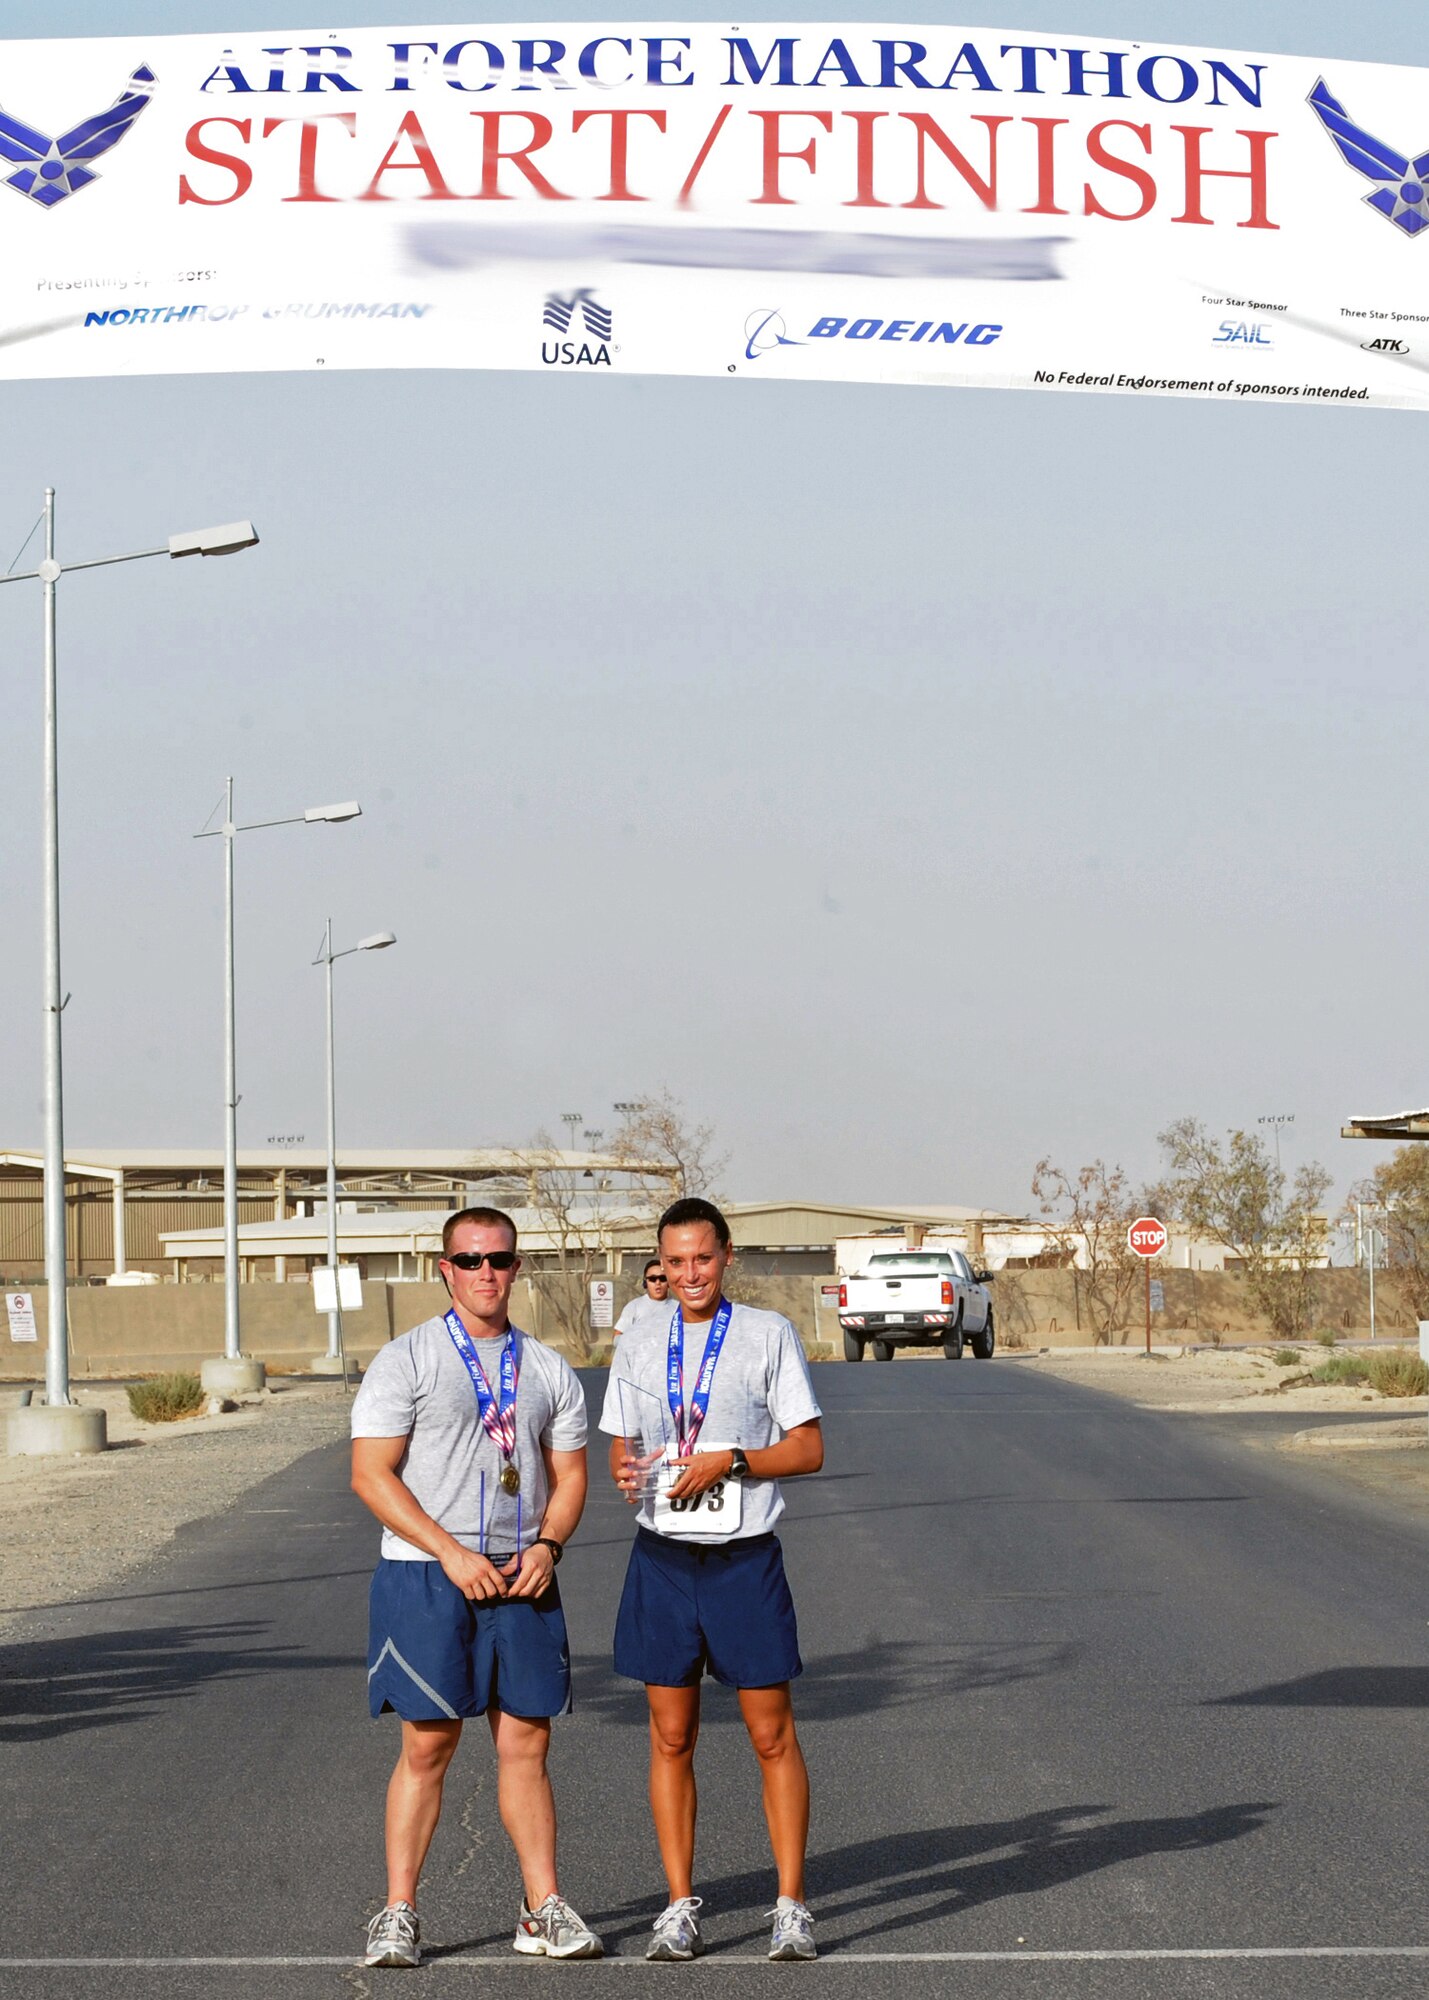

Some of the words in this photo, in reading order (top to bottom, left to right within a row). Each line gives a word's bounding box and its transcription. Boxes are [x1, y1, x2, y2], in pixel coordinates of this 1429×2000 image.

[198, 46, 363, 93] AIR
[385, 38, 695, 92] FORCE
[720, 37, 1268, 108] MARATHON
[178, 104, 1281, 230] START/FINISH
[1201, 295, 1224, 306] Four
[1226, 297, 1246, 307] Star
[1248, 299, 1288, 312] Sponsor
[1340, 307, 1367, 319] Three
[1369, 309, 1389, 319] Star
[83, 304, 249, 328] NORTHROP
[806, 316, 1004, 346] BOEING
[1212, 319, 1273, 344] SAIC
[541, 342, 612, 366] USAA
[1369, 338, 1403, 352] ATK
[1033, 370, 1055, 384] No
[1058, 371, 1115, 387] Federal
[1116, 374, 1214, 391] Endorsement
[1217, 379, 1235, 392] of
[1234, 382, 1300, 396] sponsors
[1302, 384, 1370, 400] intended.
[1132, 1230, 1165, 1246] STOP
